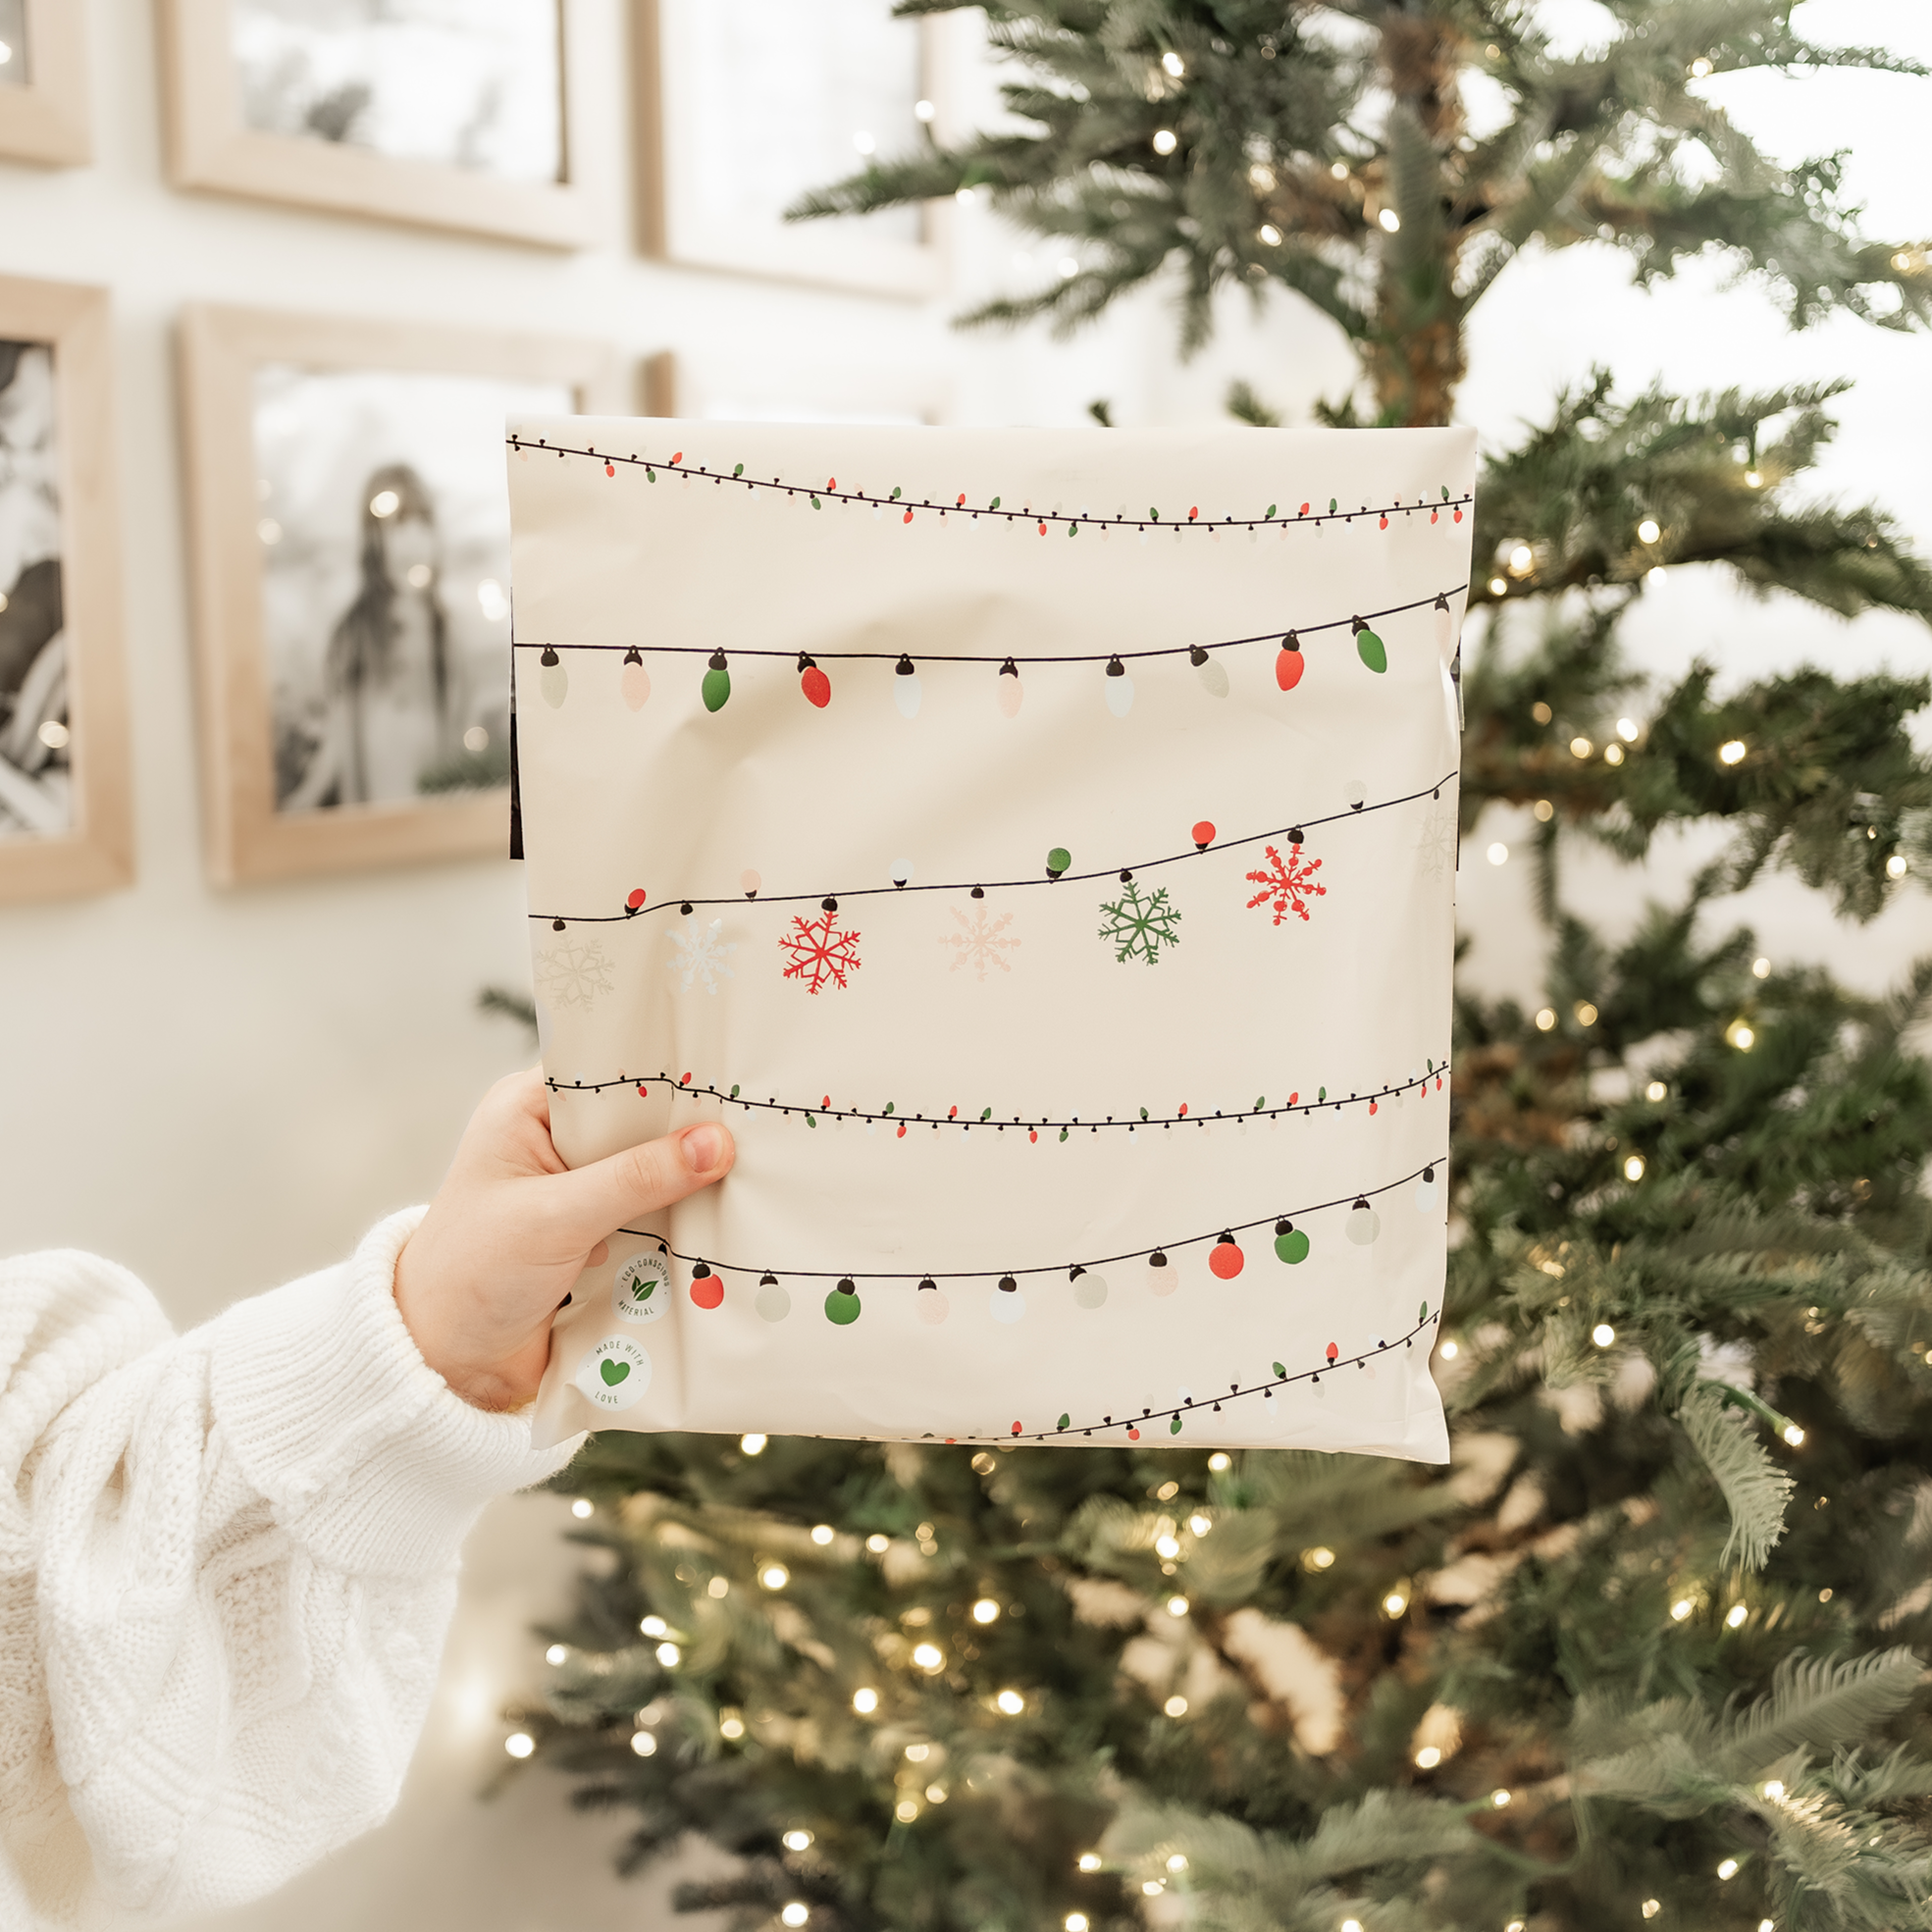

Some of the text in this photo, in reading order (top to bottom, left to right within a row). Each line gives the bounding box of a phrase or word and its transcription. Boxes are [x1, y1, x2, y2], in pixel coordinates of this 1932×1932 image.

[621, 1258, 669, 1286] ECO-CONSCIOUS
[617, 1299, 654, 1316] MATERIAL
[596, 1340, 645, 1366] MADE WITH
[595, 1390, 618, 1404] LOVE
